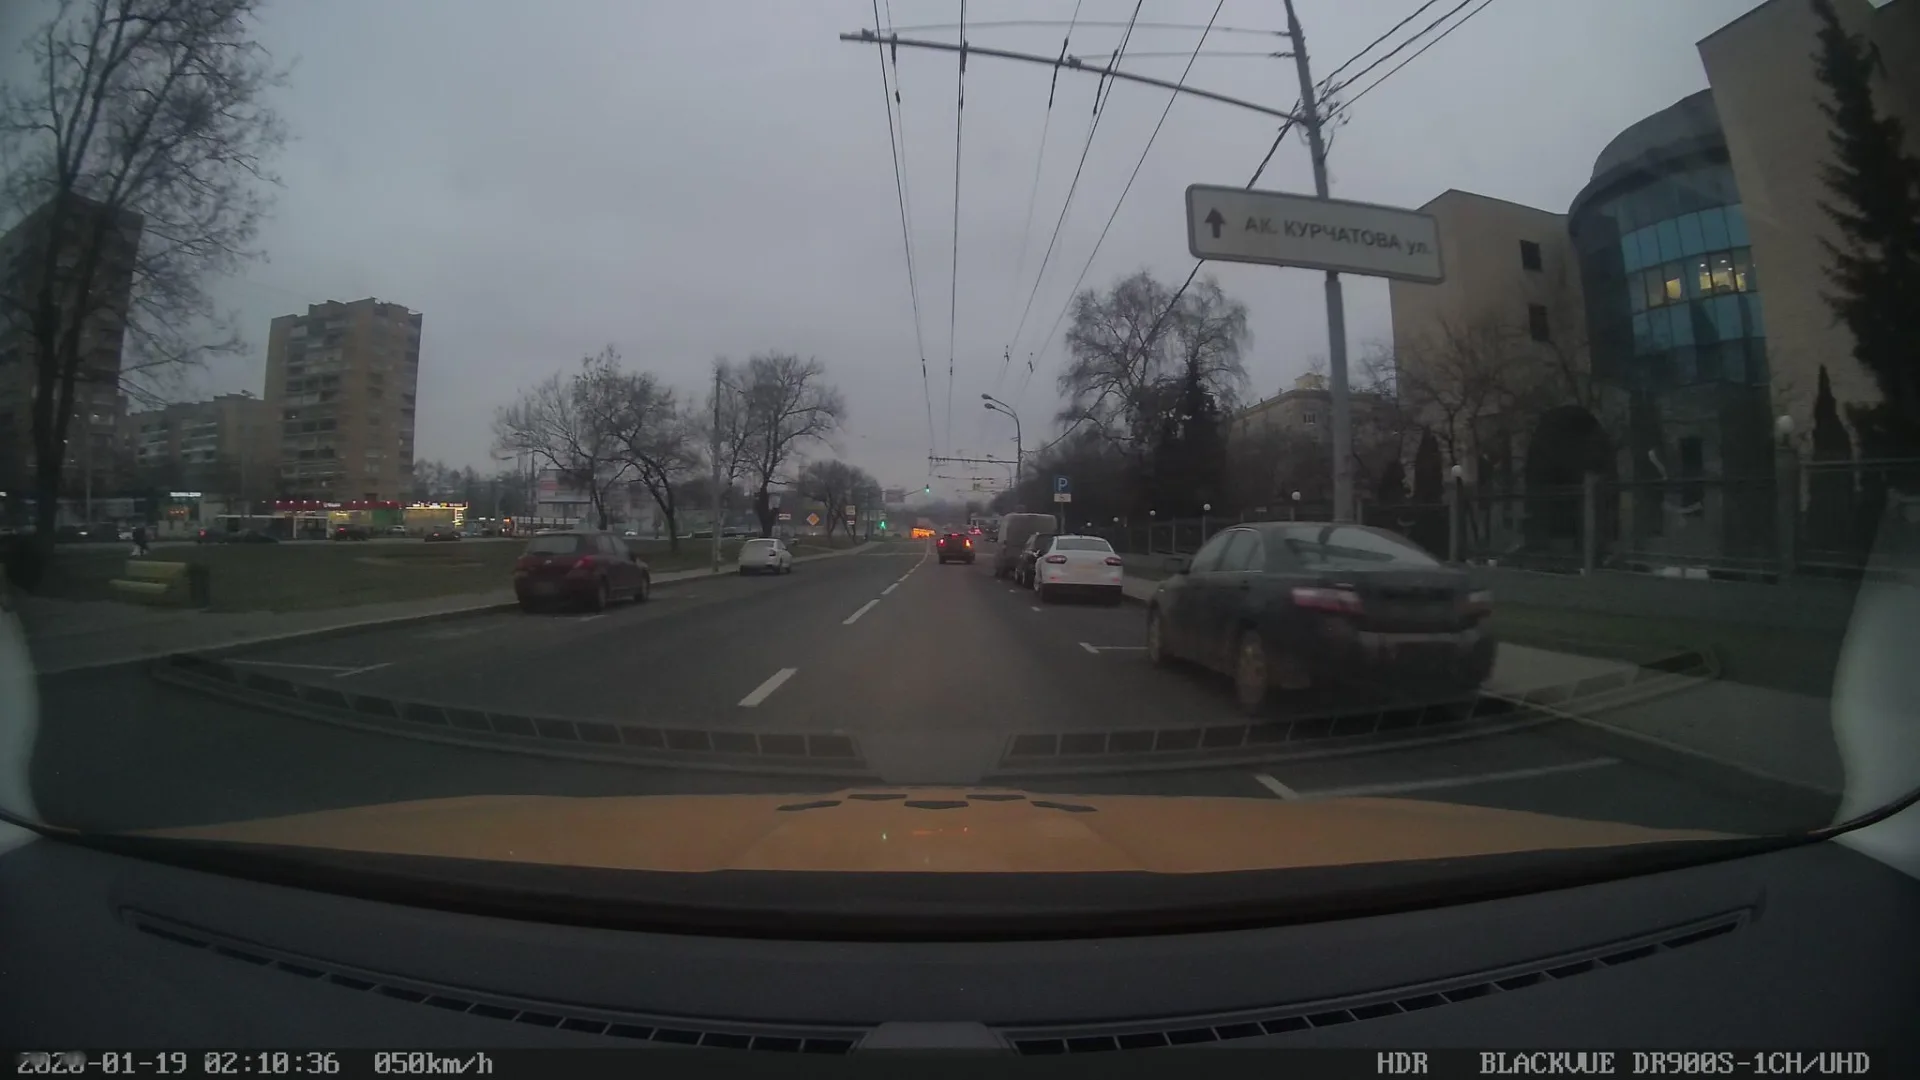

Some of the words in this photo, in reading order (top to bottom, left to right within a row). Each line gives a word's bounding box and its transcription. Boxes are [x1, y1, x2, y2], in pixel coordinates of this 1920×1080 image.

[1244, 216, 1278, 235] АК.
[1283, 220, 1402, 251] КУРЧАТОВА
[1406, 239, 1432, 257] ул.
[1058, 477, 1068, 491] P
